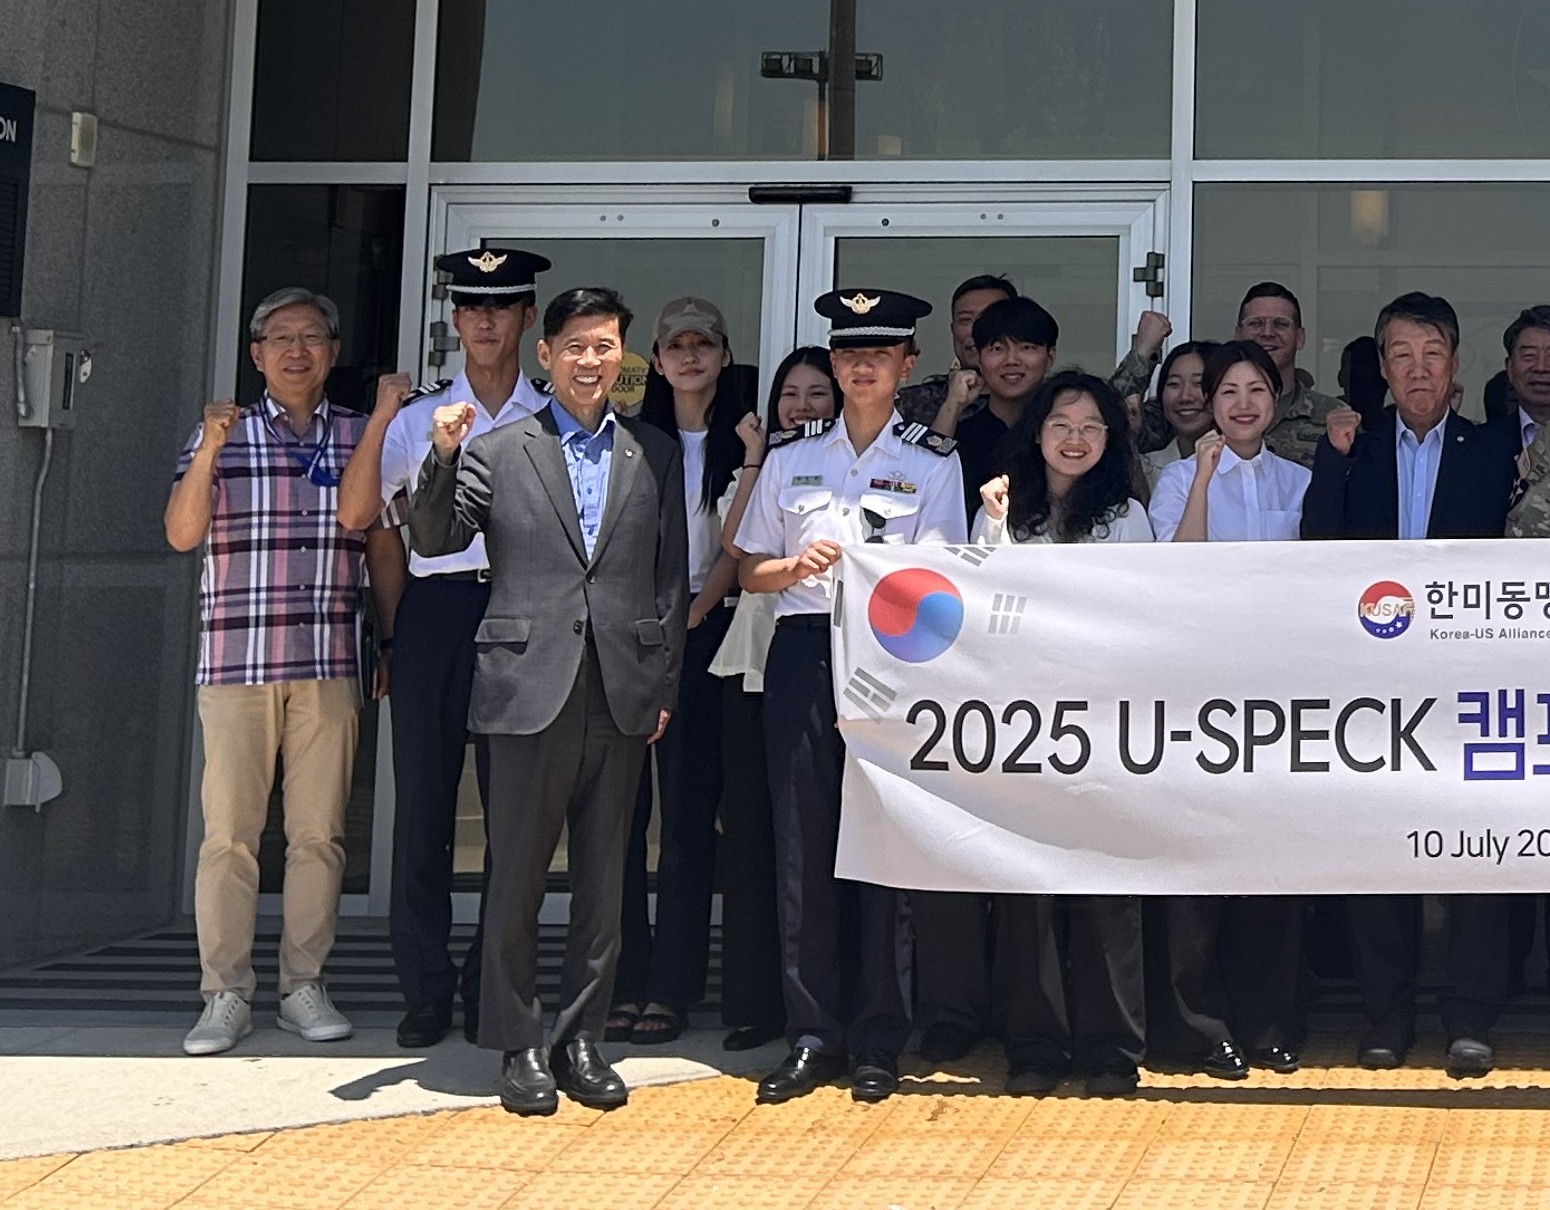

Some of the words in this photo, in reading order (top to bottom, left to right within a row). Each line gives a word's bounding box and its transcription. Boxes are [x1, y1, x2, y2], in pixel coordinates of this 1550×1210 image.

[1430, 627, 1494, 640] Korea-US
[905, 699, 1091, 775] 2025
[1118, 697, 1438, 775] U-SPECK
[1406, 829, 1443, 859] 10
[1450, 828, 1510, 866] July
